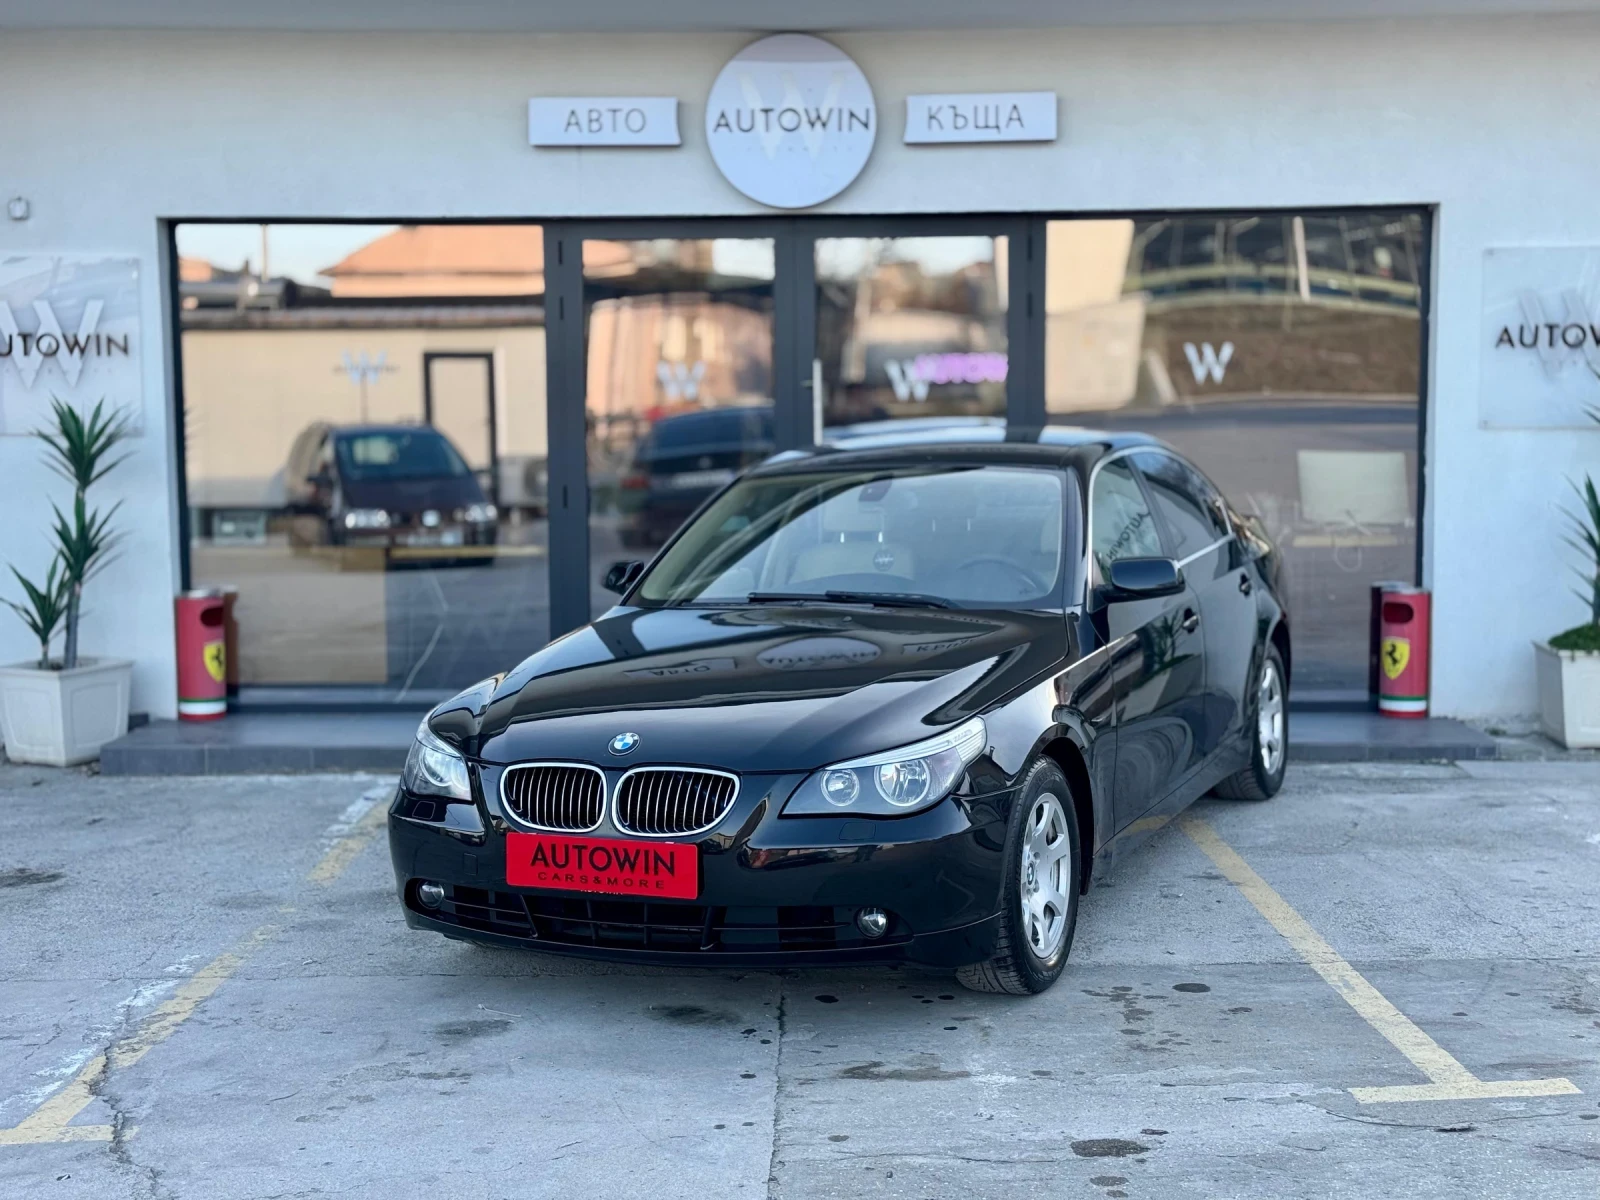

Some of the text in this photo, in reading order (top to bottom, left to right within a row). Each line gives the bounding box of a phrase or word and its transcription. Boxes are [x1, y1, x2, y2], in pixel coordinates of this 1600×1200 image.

[564, 108, 648, 134] АВТО
[713, 107, 871, 133] AUTOWIN
[927, 103, 1025, 133] КЪЩА
[1182, 340, 1235, 386] W
[530, 841, 675, 878] AUTOWIN
[537, 871, 665, 890] CARS&MORE
